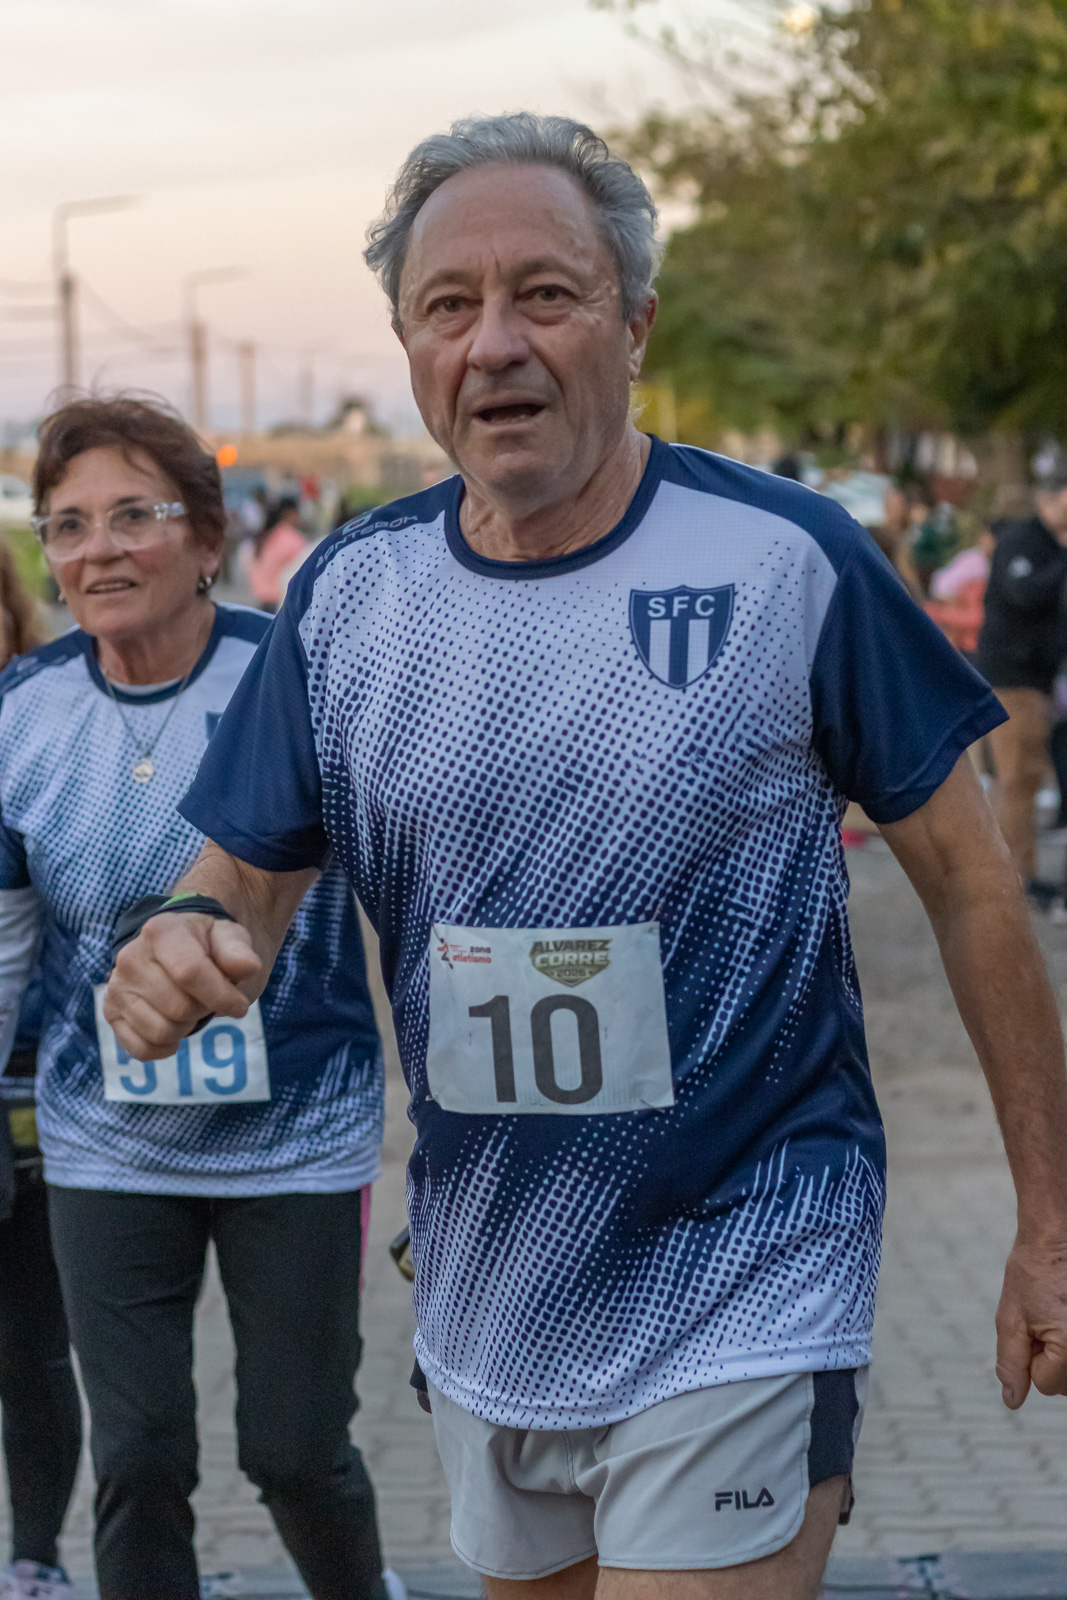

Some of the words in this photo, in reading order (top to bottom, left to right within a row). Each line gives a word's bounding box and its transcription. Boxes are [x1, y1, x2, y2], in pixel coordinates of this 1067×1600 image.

[647, 595, 715, 618] SFC
[531, 939, 612, 953] ALVAREZ
[535, 951, 608, 967] CORRE
[468, 994, 603, 1105] 10
[714, 1487, 775, 1512] FILA
